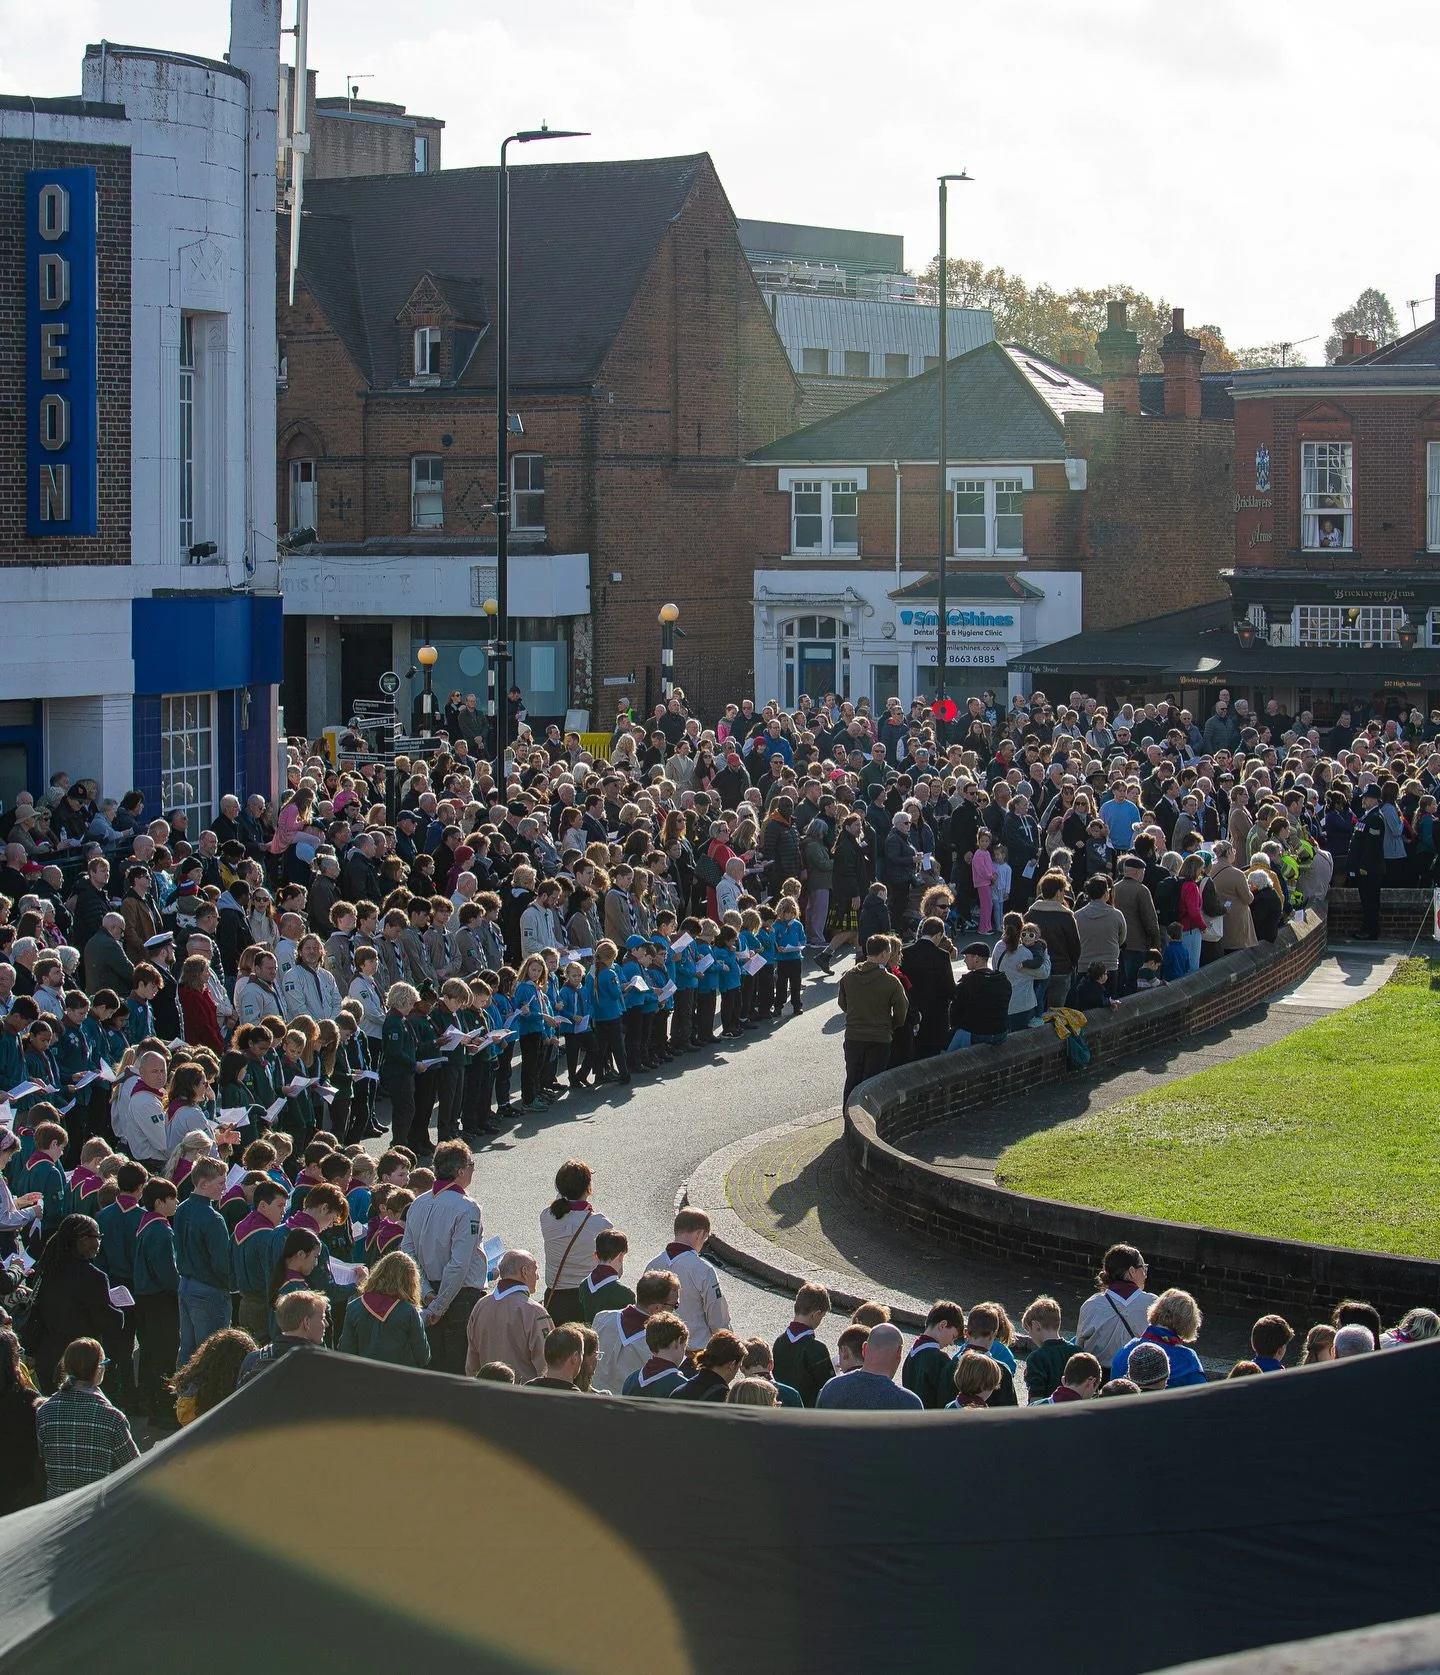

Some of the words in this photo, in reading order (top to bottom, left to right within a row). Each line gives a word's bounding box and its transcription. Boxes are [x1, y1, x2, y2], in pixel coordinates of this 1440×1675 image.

[39, 184, 71, 521] ODEON
[1233, 491, 1272, 512] Bricklayers
[1249, 523, 1272, 548] Arms
[1334, 589, 1386, 599] Bricklayers
[1384, 589, 1415, 602] Arms
[915, 611, 1014, 626] SmleShines
[957, 629, 984, 638] Hygiene
[925, 643, 1000, 651] wwmileshines.co.uk
[950, 655, 971, 663] 8663
[973, 655, 995, 663] 6885
[1029, 665, 1041, 673] High
